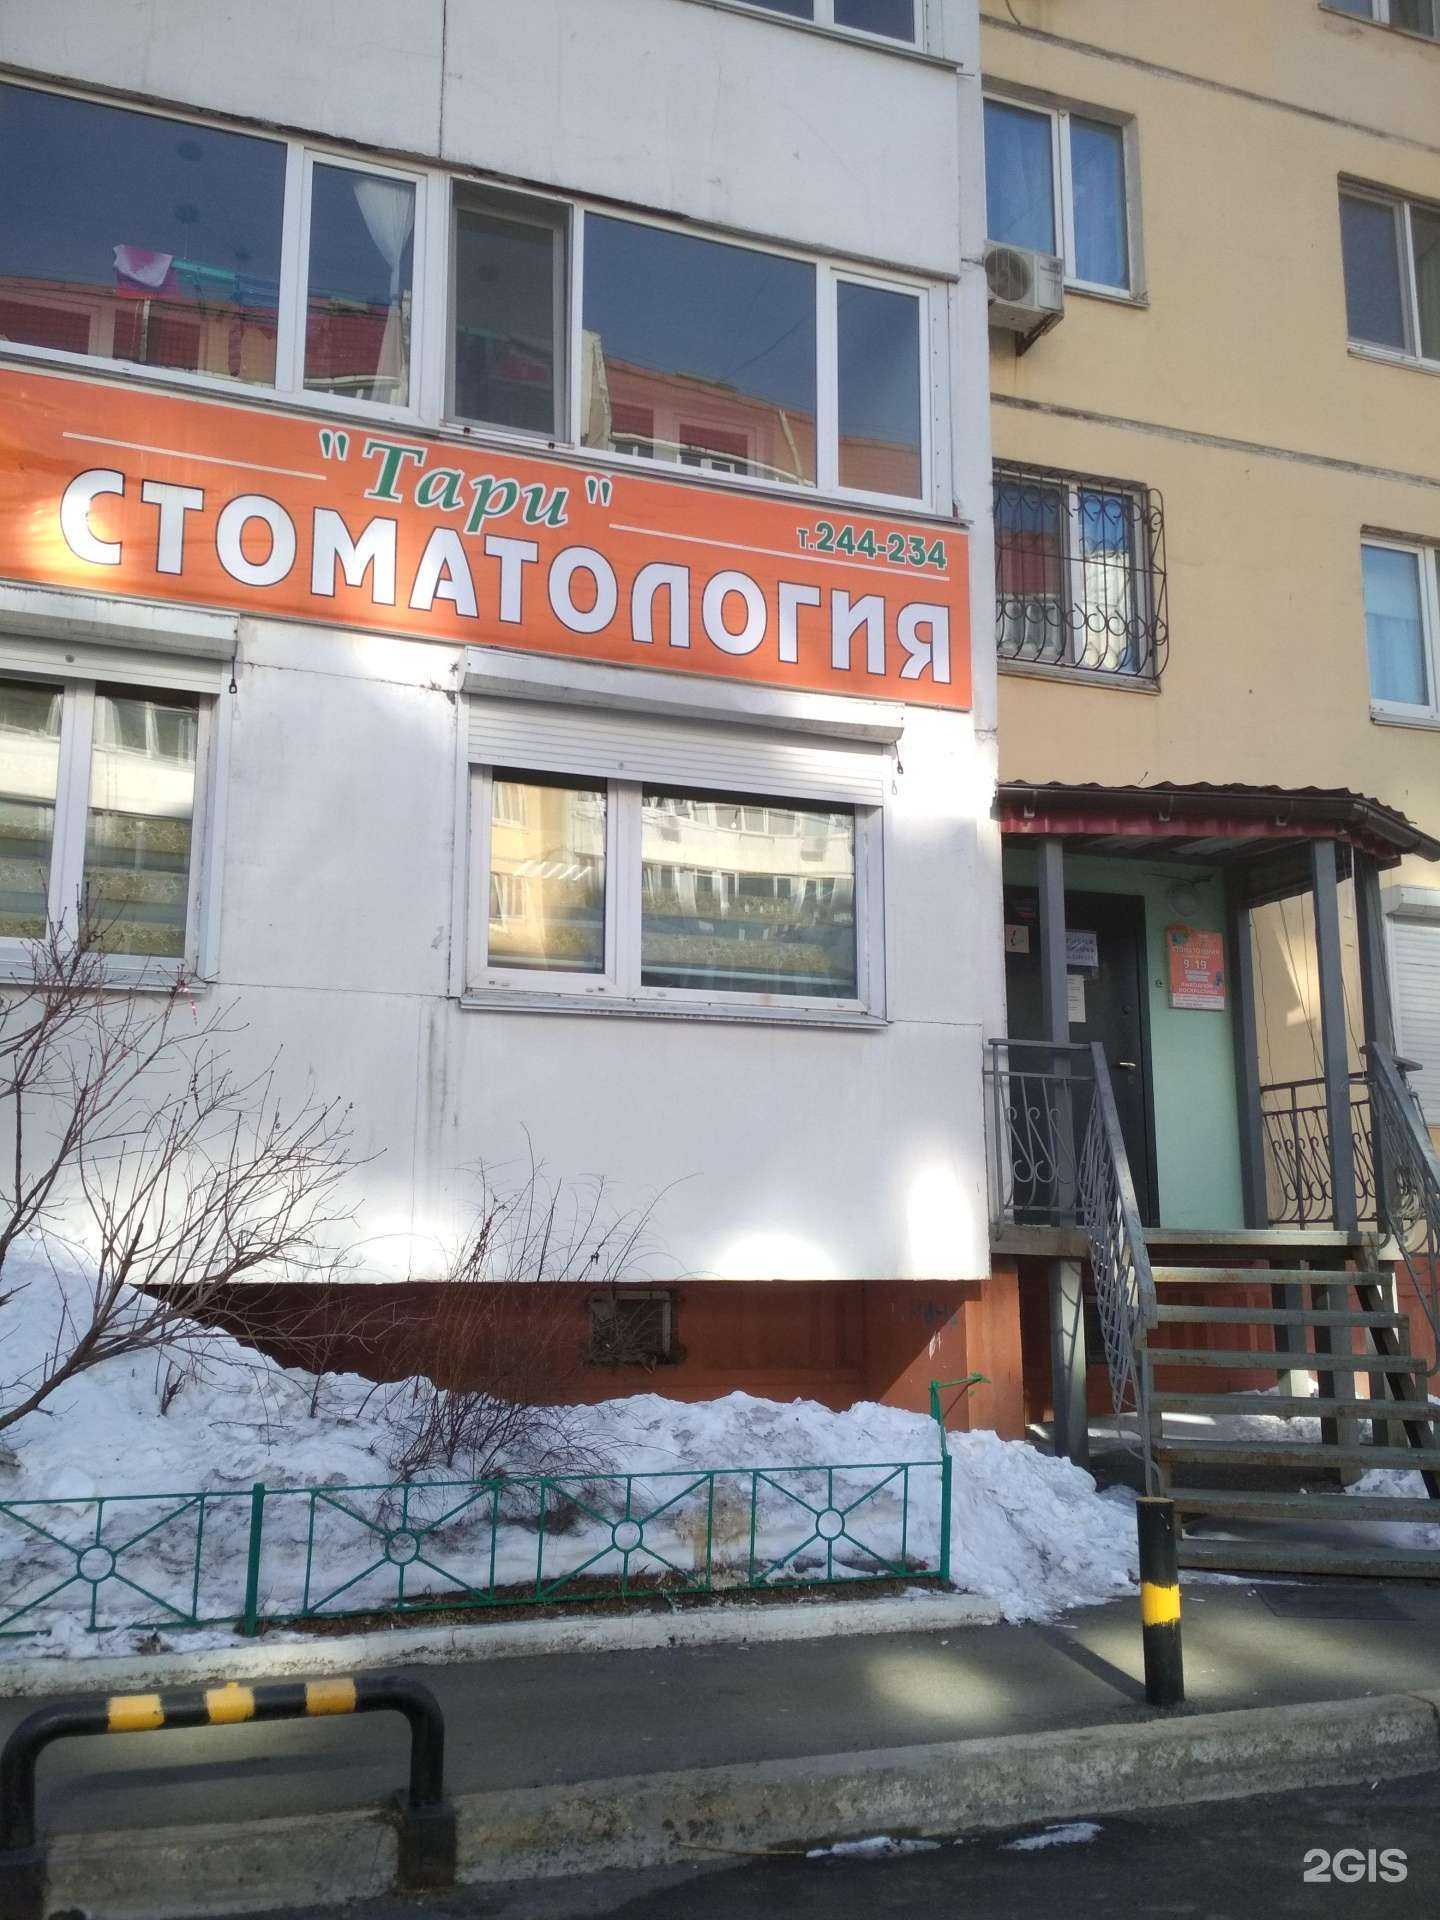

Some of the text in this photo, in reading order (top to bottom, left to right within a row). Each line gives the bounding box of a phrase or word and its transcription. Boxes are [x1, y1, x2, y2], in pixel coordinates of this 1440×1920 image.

[319, 429, 612, 534] "Тари"
[60, 468, 952, 684] СТОМАТОЛОГИЯ
[797, 520, 949, 570] т.244-234
